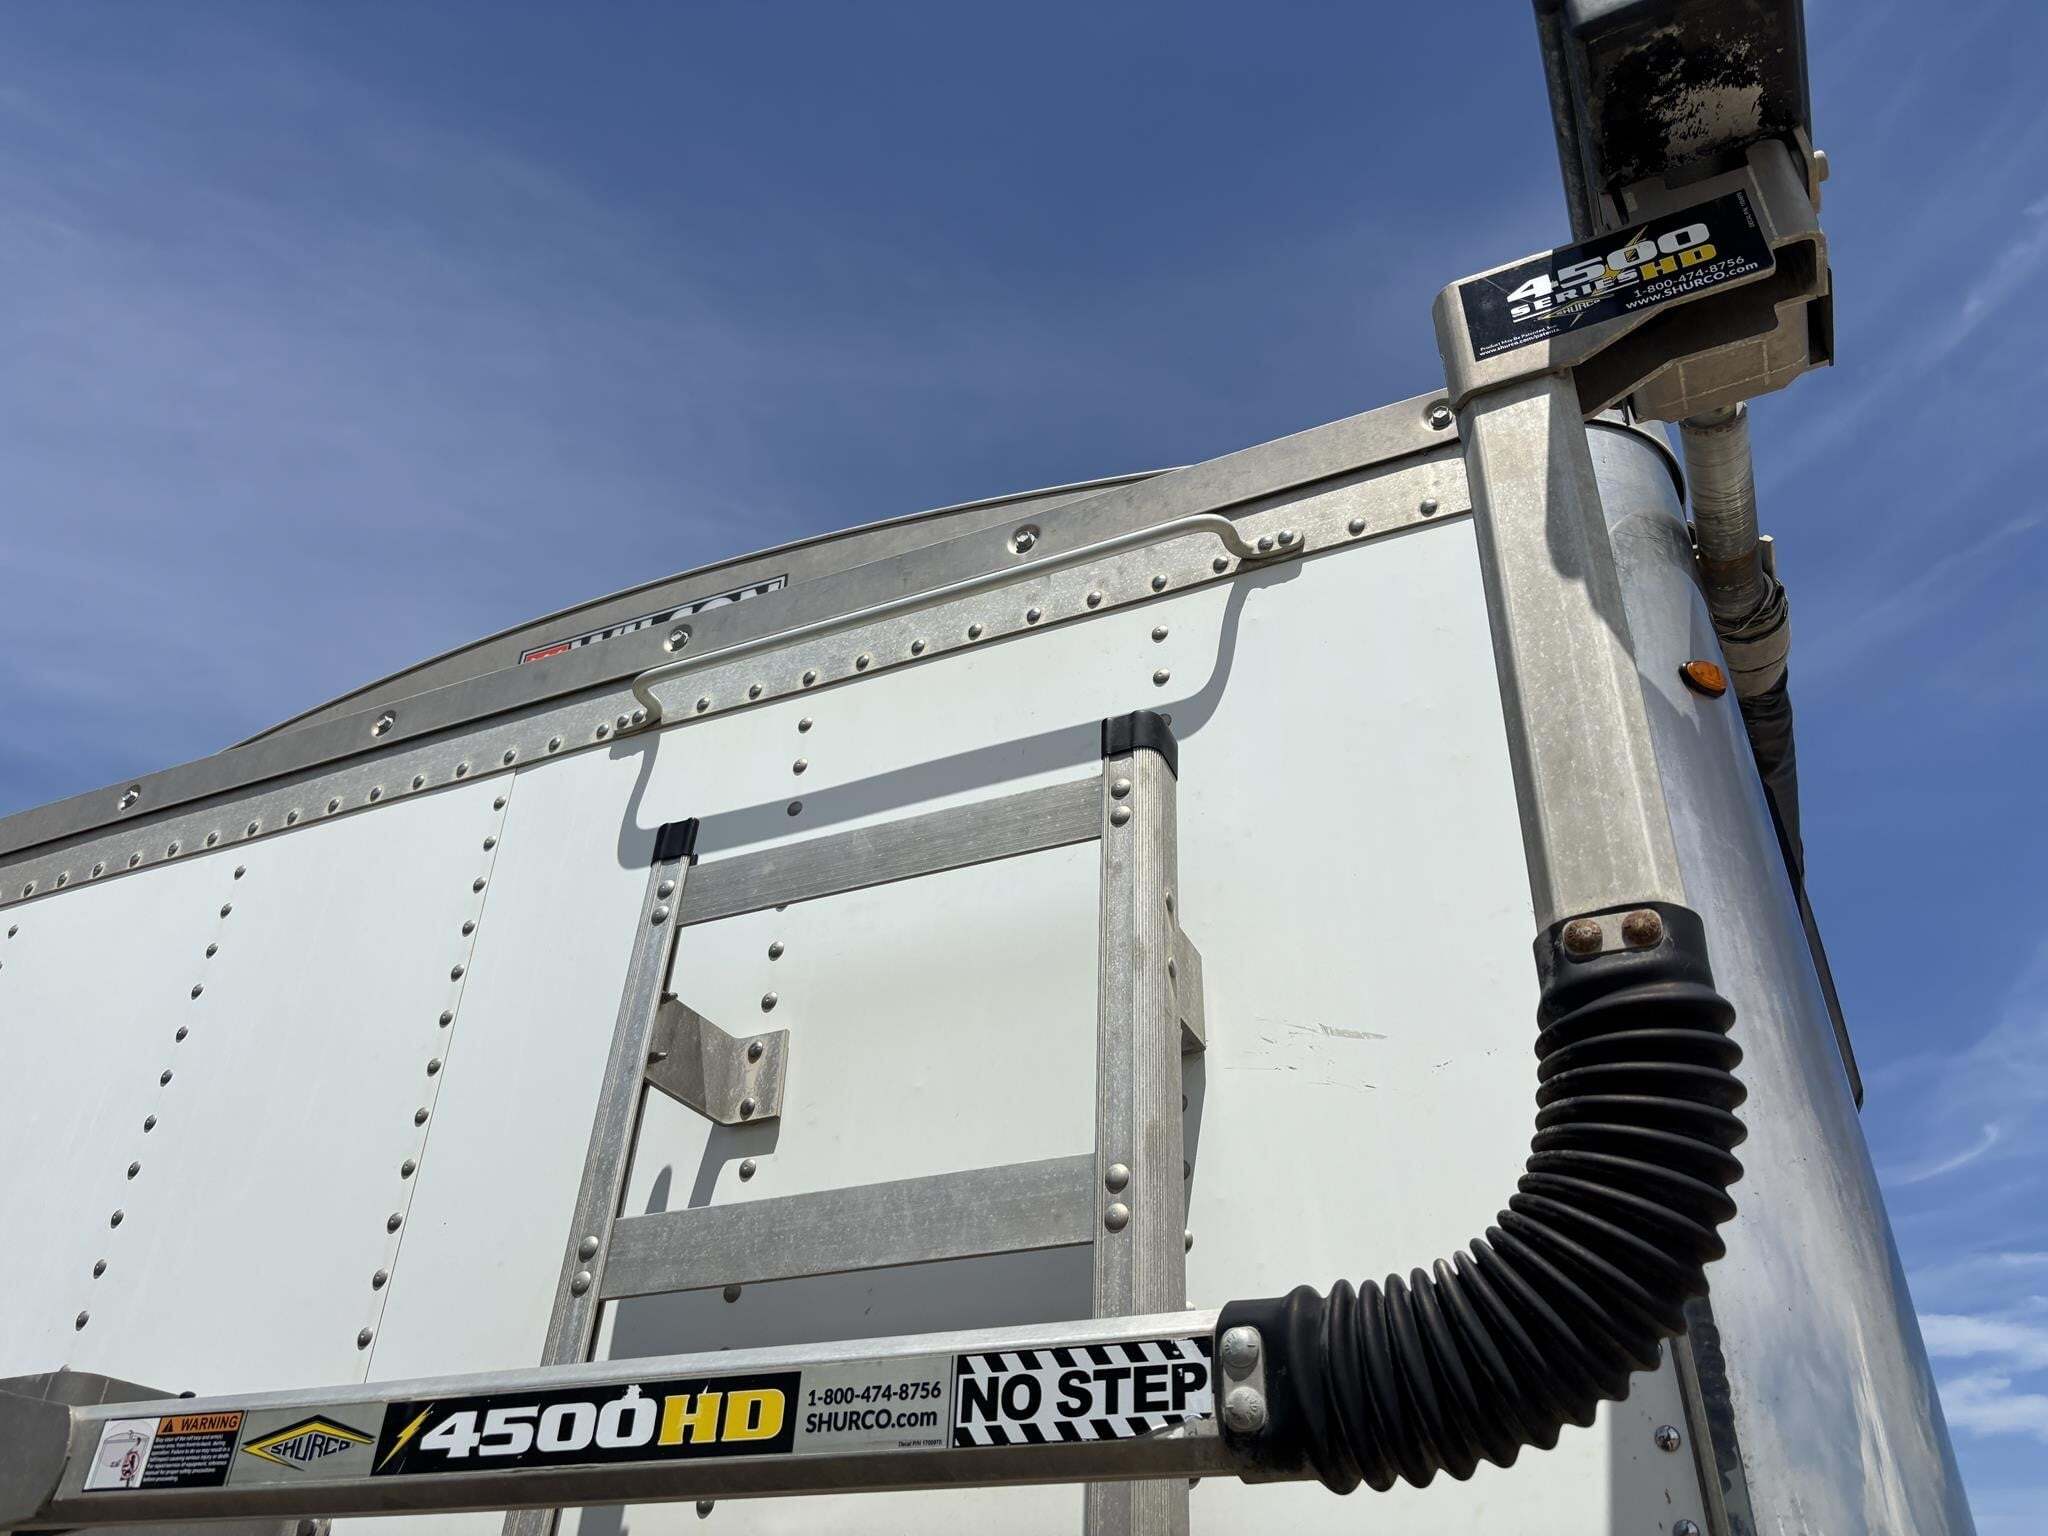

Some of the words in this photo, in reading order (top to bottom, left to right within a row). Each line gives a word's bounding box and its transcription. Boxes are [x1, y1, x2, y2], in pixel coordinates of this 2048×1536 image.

[1507, 223, 1710, 302] 4500
[1510, 269, 1638, 318] SERIES
[1640, 244, 1717, 280] HD
[1633, 256, 1744, 298] 1-800-474-8756
[1625, 262, 1759, 309] www.SHURCO.com
[808, 1381, 942, 1406] 1-800-474-8756
[960, 1373, 1042, 1423] NO
[1056, 1362, 1207, 1418] STEP
[181, 1415, 238, 1430] WARNING
[805, 1409, 938, 1433] SHURCO.com
[270, 1434, 351, 1461] SHURCO
